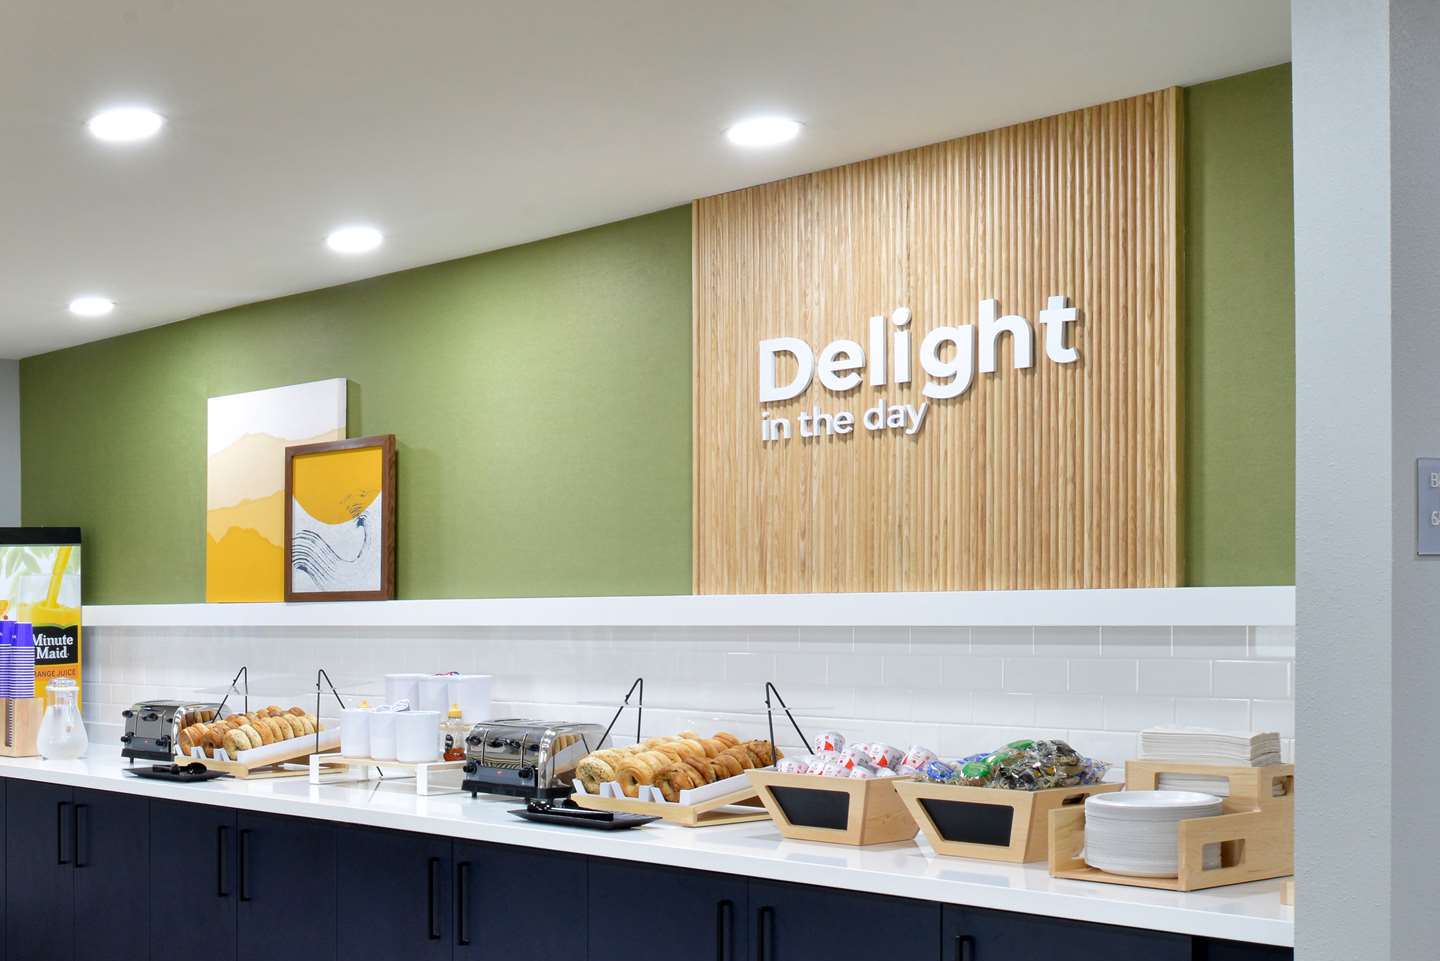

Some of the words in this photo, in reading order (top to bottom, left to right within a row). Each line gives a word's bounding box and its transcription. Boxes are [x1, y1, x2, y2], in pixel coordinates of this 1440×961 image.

[759, 295, 1080, 402] Delight
[761, 411, 792, 441] in
[798, 405, 855, 437] the
[863, 399, 929, 435] day
[32, 633, 74, 646] Minute
[35, 646, 68, 659] Maid
